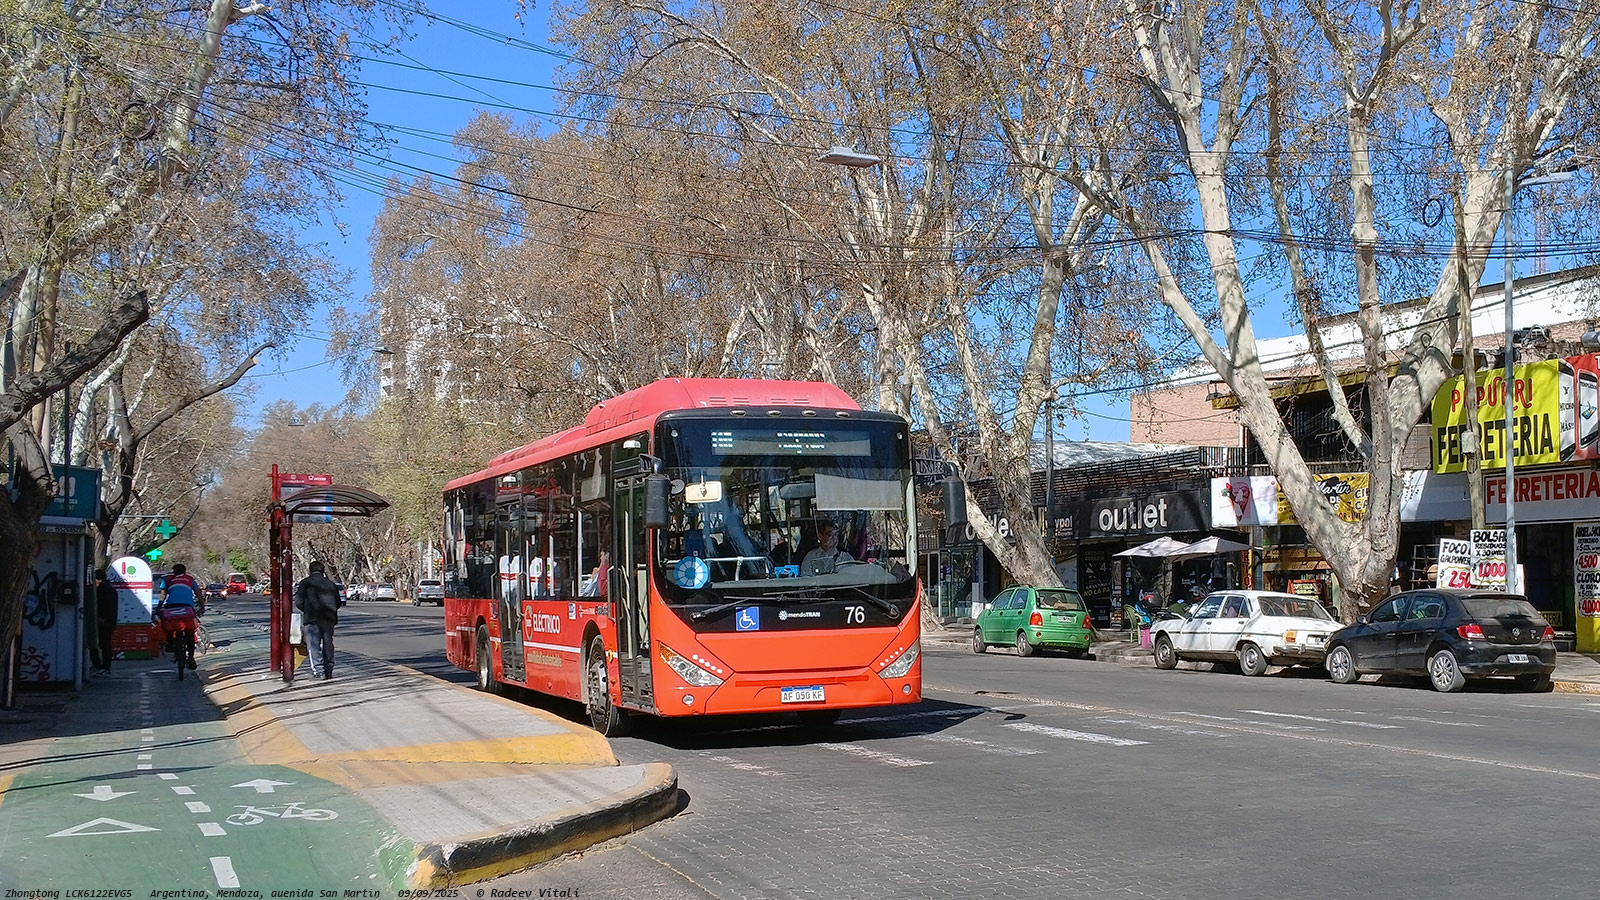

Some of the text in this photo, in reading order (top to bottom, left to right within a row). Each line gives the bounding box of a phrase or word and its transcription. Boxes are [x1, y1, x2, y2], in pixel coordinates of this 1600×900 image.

[1098, 498, 1168, 531] outlet
[532, 610, 561, 635] ELÉCTRICO
[844, 605, 866, 624] 76
[783, 692, 793, 701] AF
